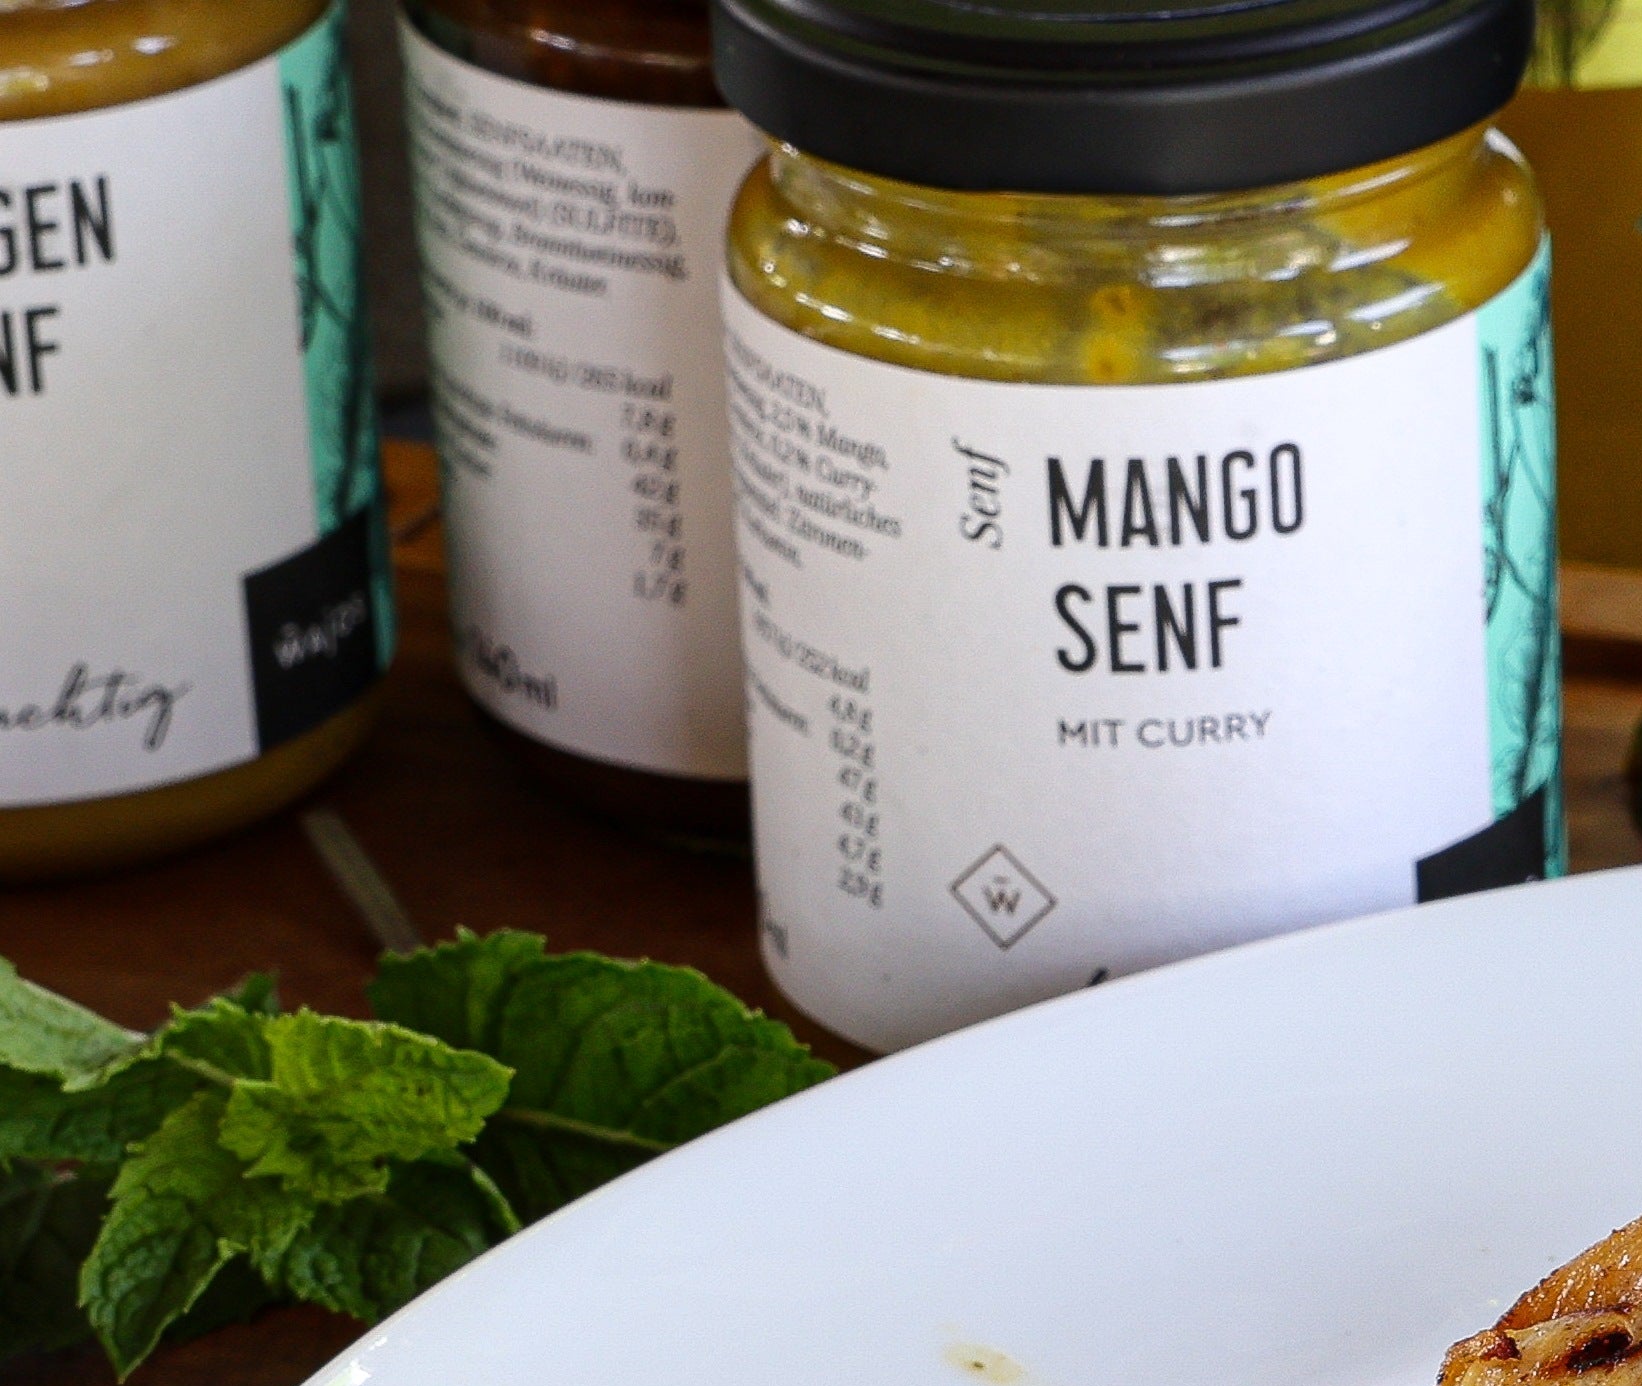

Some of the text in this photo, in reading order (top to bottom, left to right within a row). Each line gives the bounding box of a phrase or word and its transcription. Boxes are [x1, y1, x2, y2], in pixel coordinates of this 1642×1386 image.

[950, 434, 1010, 550] Senf
[1047, 441, 1304, 549] MANGO
[1053, 578, 1244, 673] SENF
[1056, 710, 1272, 749] MIT CURRY
